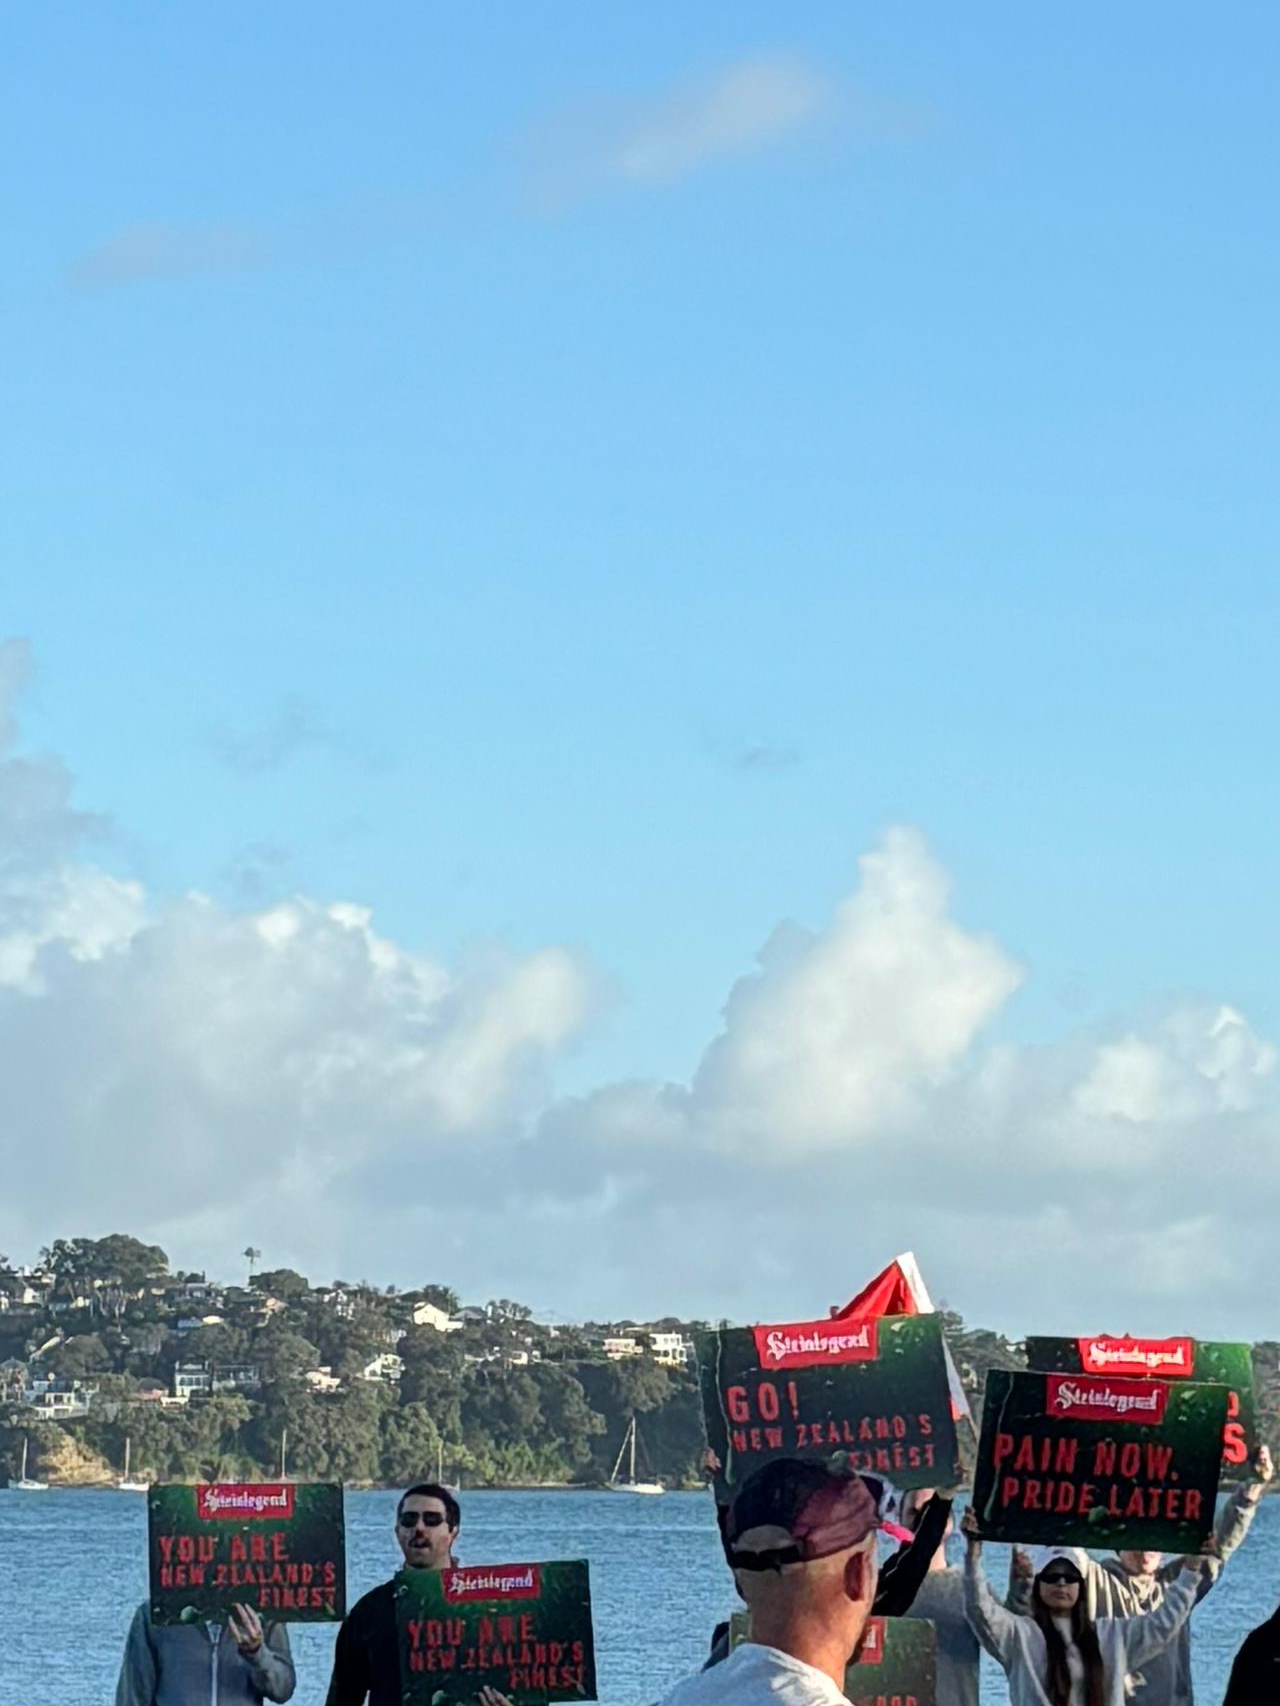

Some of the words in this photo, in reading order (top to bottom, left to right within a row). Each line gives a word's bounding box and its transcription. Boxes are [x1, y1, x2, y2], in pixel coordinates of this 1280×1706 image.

[725, 1380, 800, 1424] GO!
[731, 1426, 784, 1453] NEW
[796, 1413, 933, 1449] ZEALAND'S
[848, 1444, 935, 1471] FINEST
[993, 1433, 1079, 1474] PAIN
[1093, 1440, 1179, 1482] NOW.
[1001, 1476, 1099, 1515] PRIDE
[1106, 1484, 1204, 1521] LATER
[159, 1535, 215, 1563] YOU
[230, 1532, 289, 1562] ARE
[160, 1563, 206, 1588] NEW
[214, 1561, 336, 1587] ZEALAND'S
[258, 1587, 336, 1609] FINEST
[406, 1618, 464, 1649] YOU
[478, 1613, 536, 1644] ARE
[410, 1648, 456, 1673] NEW
[461, 1639, 584, 1669] ZEALAND'S
[509, 1666, 584, 1691] FINEST
